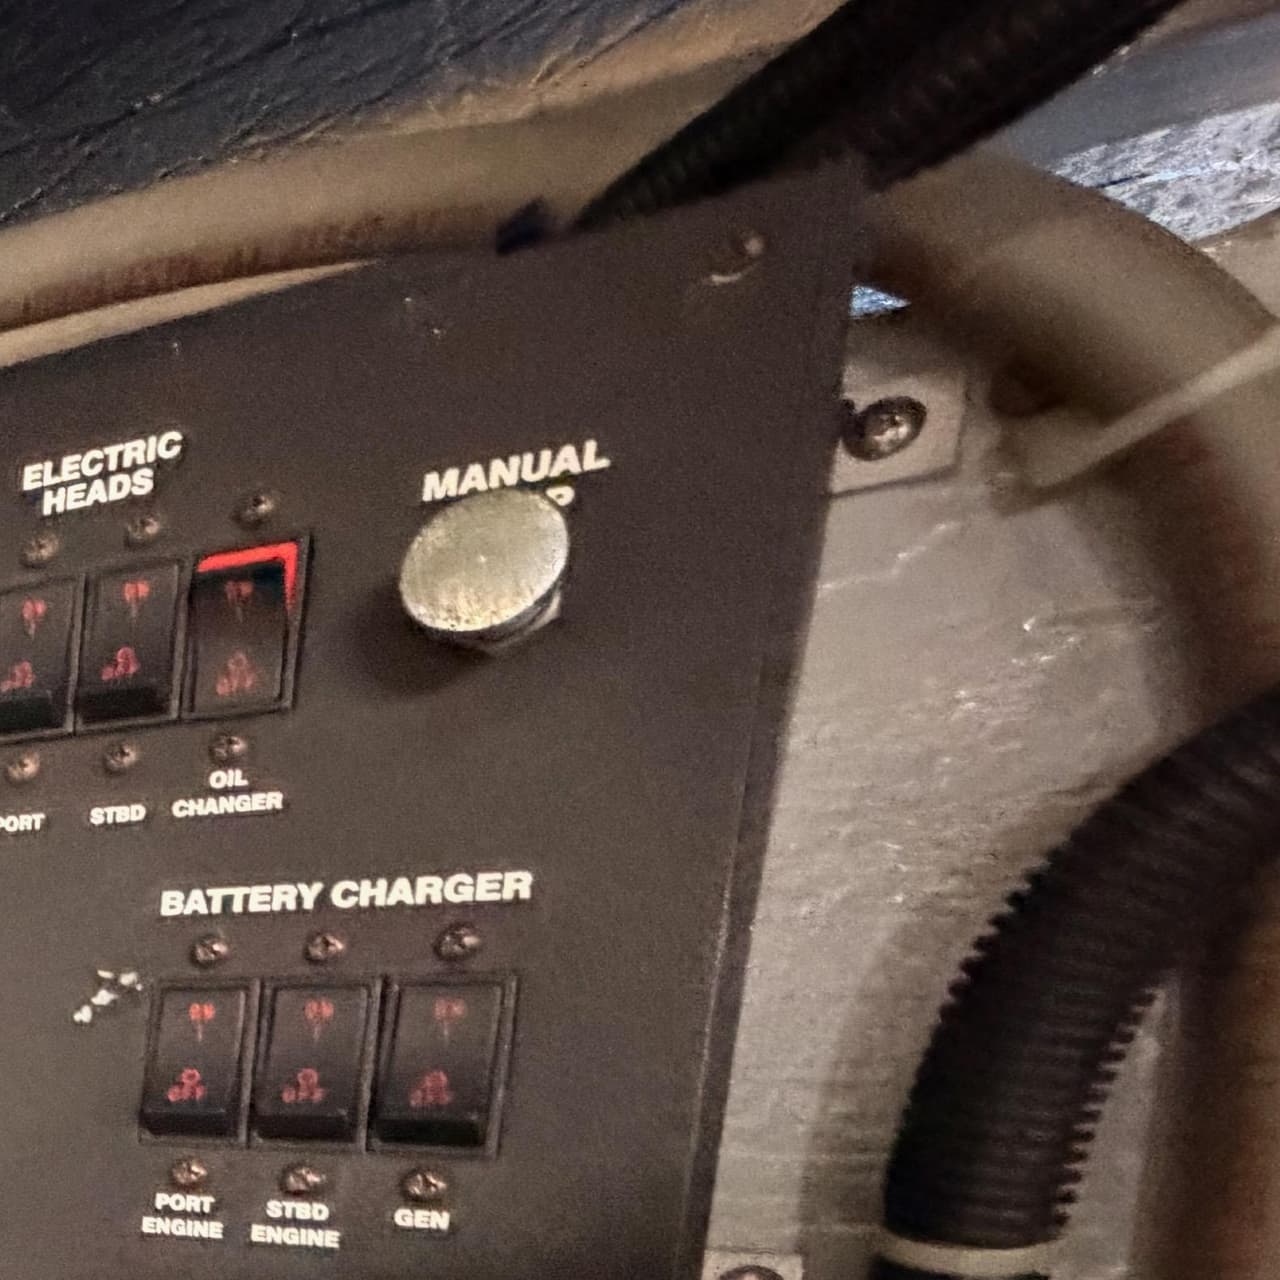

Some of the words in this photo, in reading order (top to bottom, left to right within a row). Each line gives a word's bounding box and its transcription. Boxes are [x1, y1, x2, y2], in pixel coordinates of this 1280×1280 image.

[23, 431, 183, 491] ELECTRIC
[422, 440, 610, 501] MANUAL
[42, 468, 154, 515] HEADS
[209, 769, 248, 788] OIL
[90, 804, 146, 825] STBD
[172, 792, 283, 817] CHANGER
[161, 882, 323, 916] BATTERY
[331, 871, 533, 908] CHARGER
[155, 1193, 215, 1213] PORT
[266, 1200, 329, 1220] STBD
[142, 1216, 223, 1238] ENGINE
[394, 1208, 450, 1230] GEN
[251, 1224, 340, 1248] ENGINE
